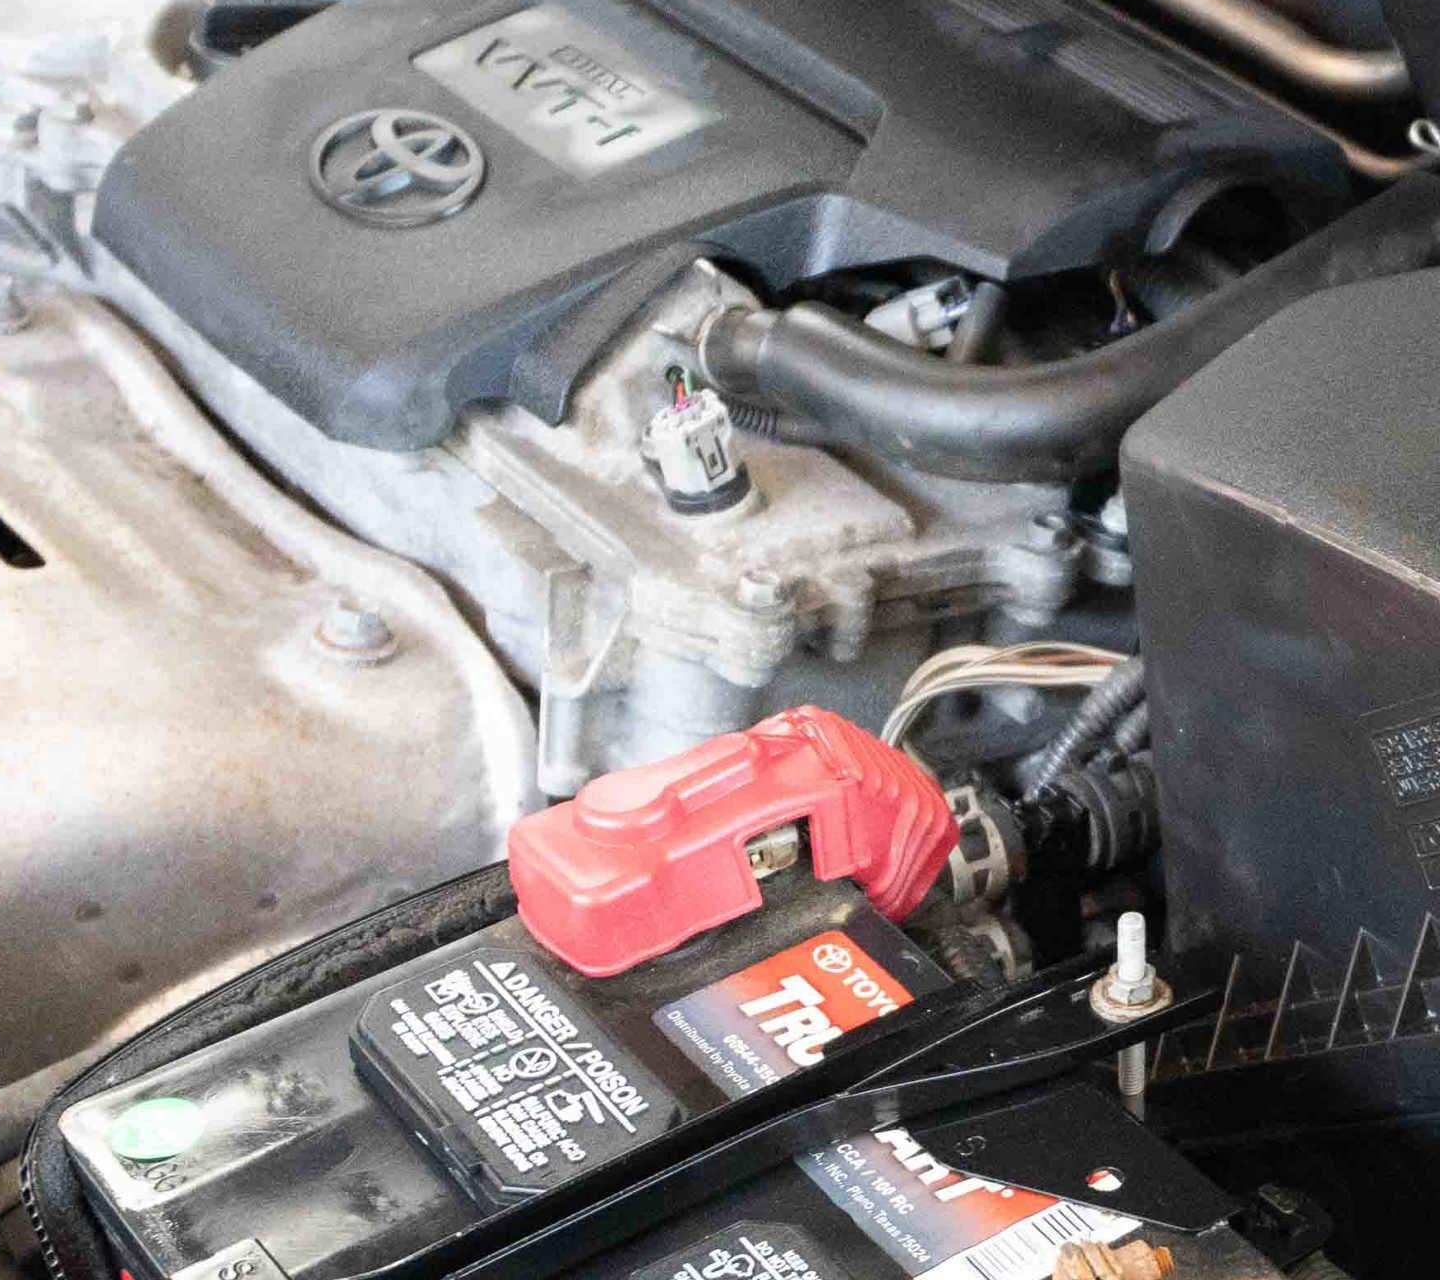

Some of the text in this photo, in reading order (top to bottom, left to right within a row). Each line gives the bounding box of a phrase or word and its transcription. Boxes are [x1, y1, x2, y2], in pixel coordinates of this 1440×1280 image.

[504, 975, 580, 1039] DANGER
[577, 1052, 650, 1117] POISON
[666, 1010, 719, 1056] Distributed
[716, 1061, 754, 1090] Toyota
[555, 1138, 587, 1161] ACID
[832, 1142, 871, 1169] CCA
[886, 1194, 917, 1216] RC
[754, 1241, 774, 1258] DO
[766, 1256, 793, 1274] NOT
[869, 1209, 905, 1237] Texas
[894, 1232, 933, 1265] 75024
